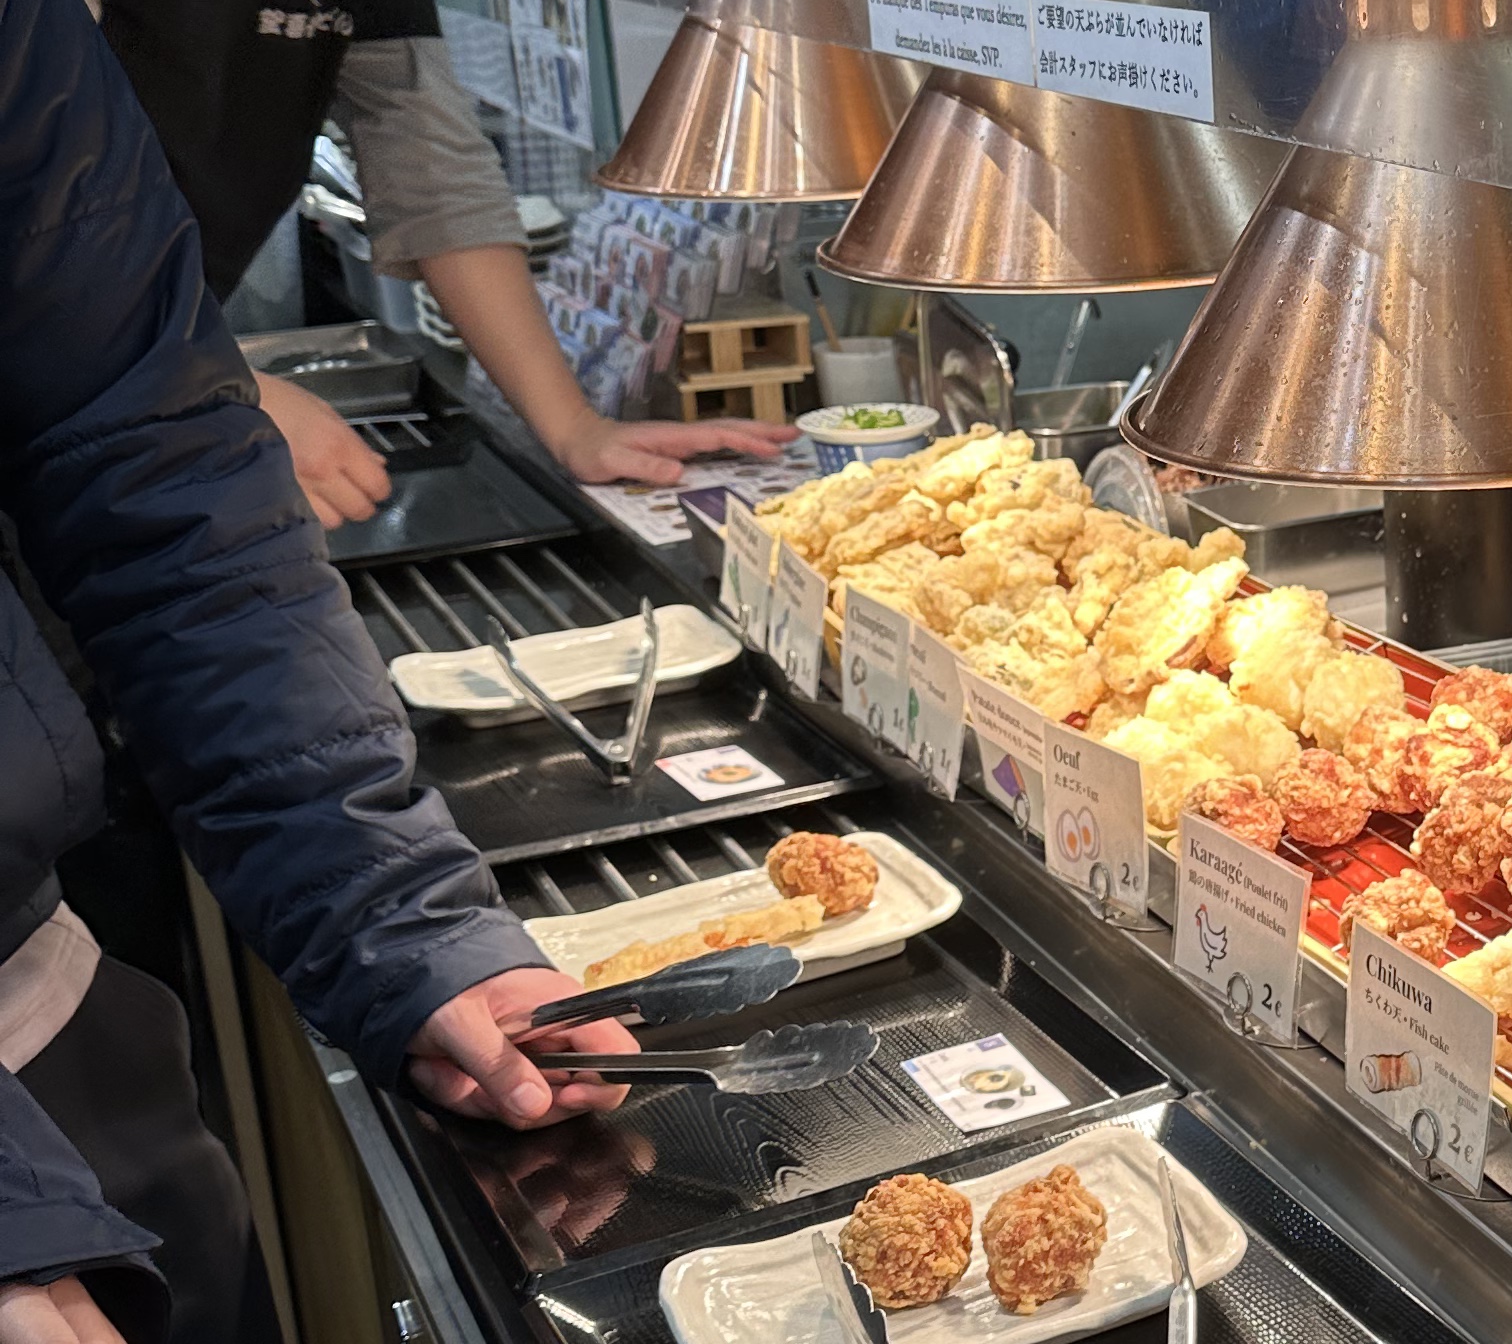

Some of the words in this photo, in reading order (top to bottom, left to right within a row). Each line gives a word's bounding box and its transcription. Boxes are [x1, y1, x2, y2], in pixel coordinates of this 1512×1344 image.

[960, 5, 975, 24] que
[976, 7, 994, 23] vous
[981, 45, 1002, 68] SVP.
[1053, 743, 1081, 771] Oeuf
[1189, 837, 1243, 885] Karaagé
[1243, 875, 1273, 902] (Poulet
[1272, 891, 1289, 913] frit)
[1234, 898, 1256, 920] Fried
[1256, 911, 1287, 939] chicken
[1366, 953, 1433, 1014] Chikuwa
[1364, 987, 1402, 1024] ちくわ天
[1409, 1016, 1428, 1042] Fish
[1429, 1032, 1450, 1056] cake
